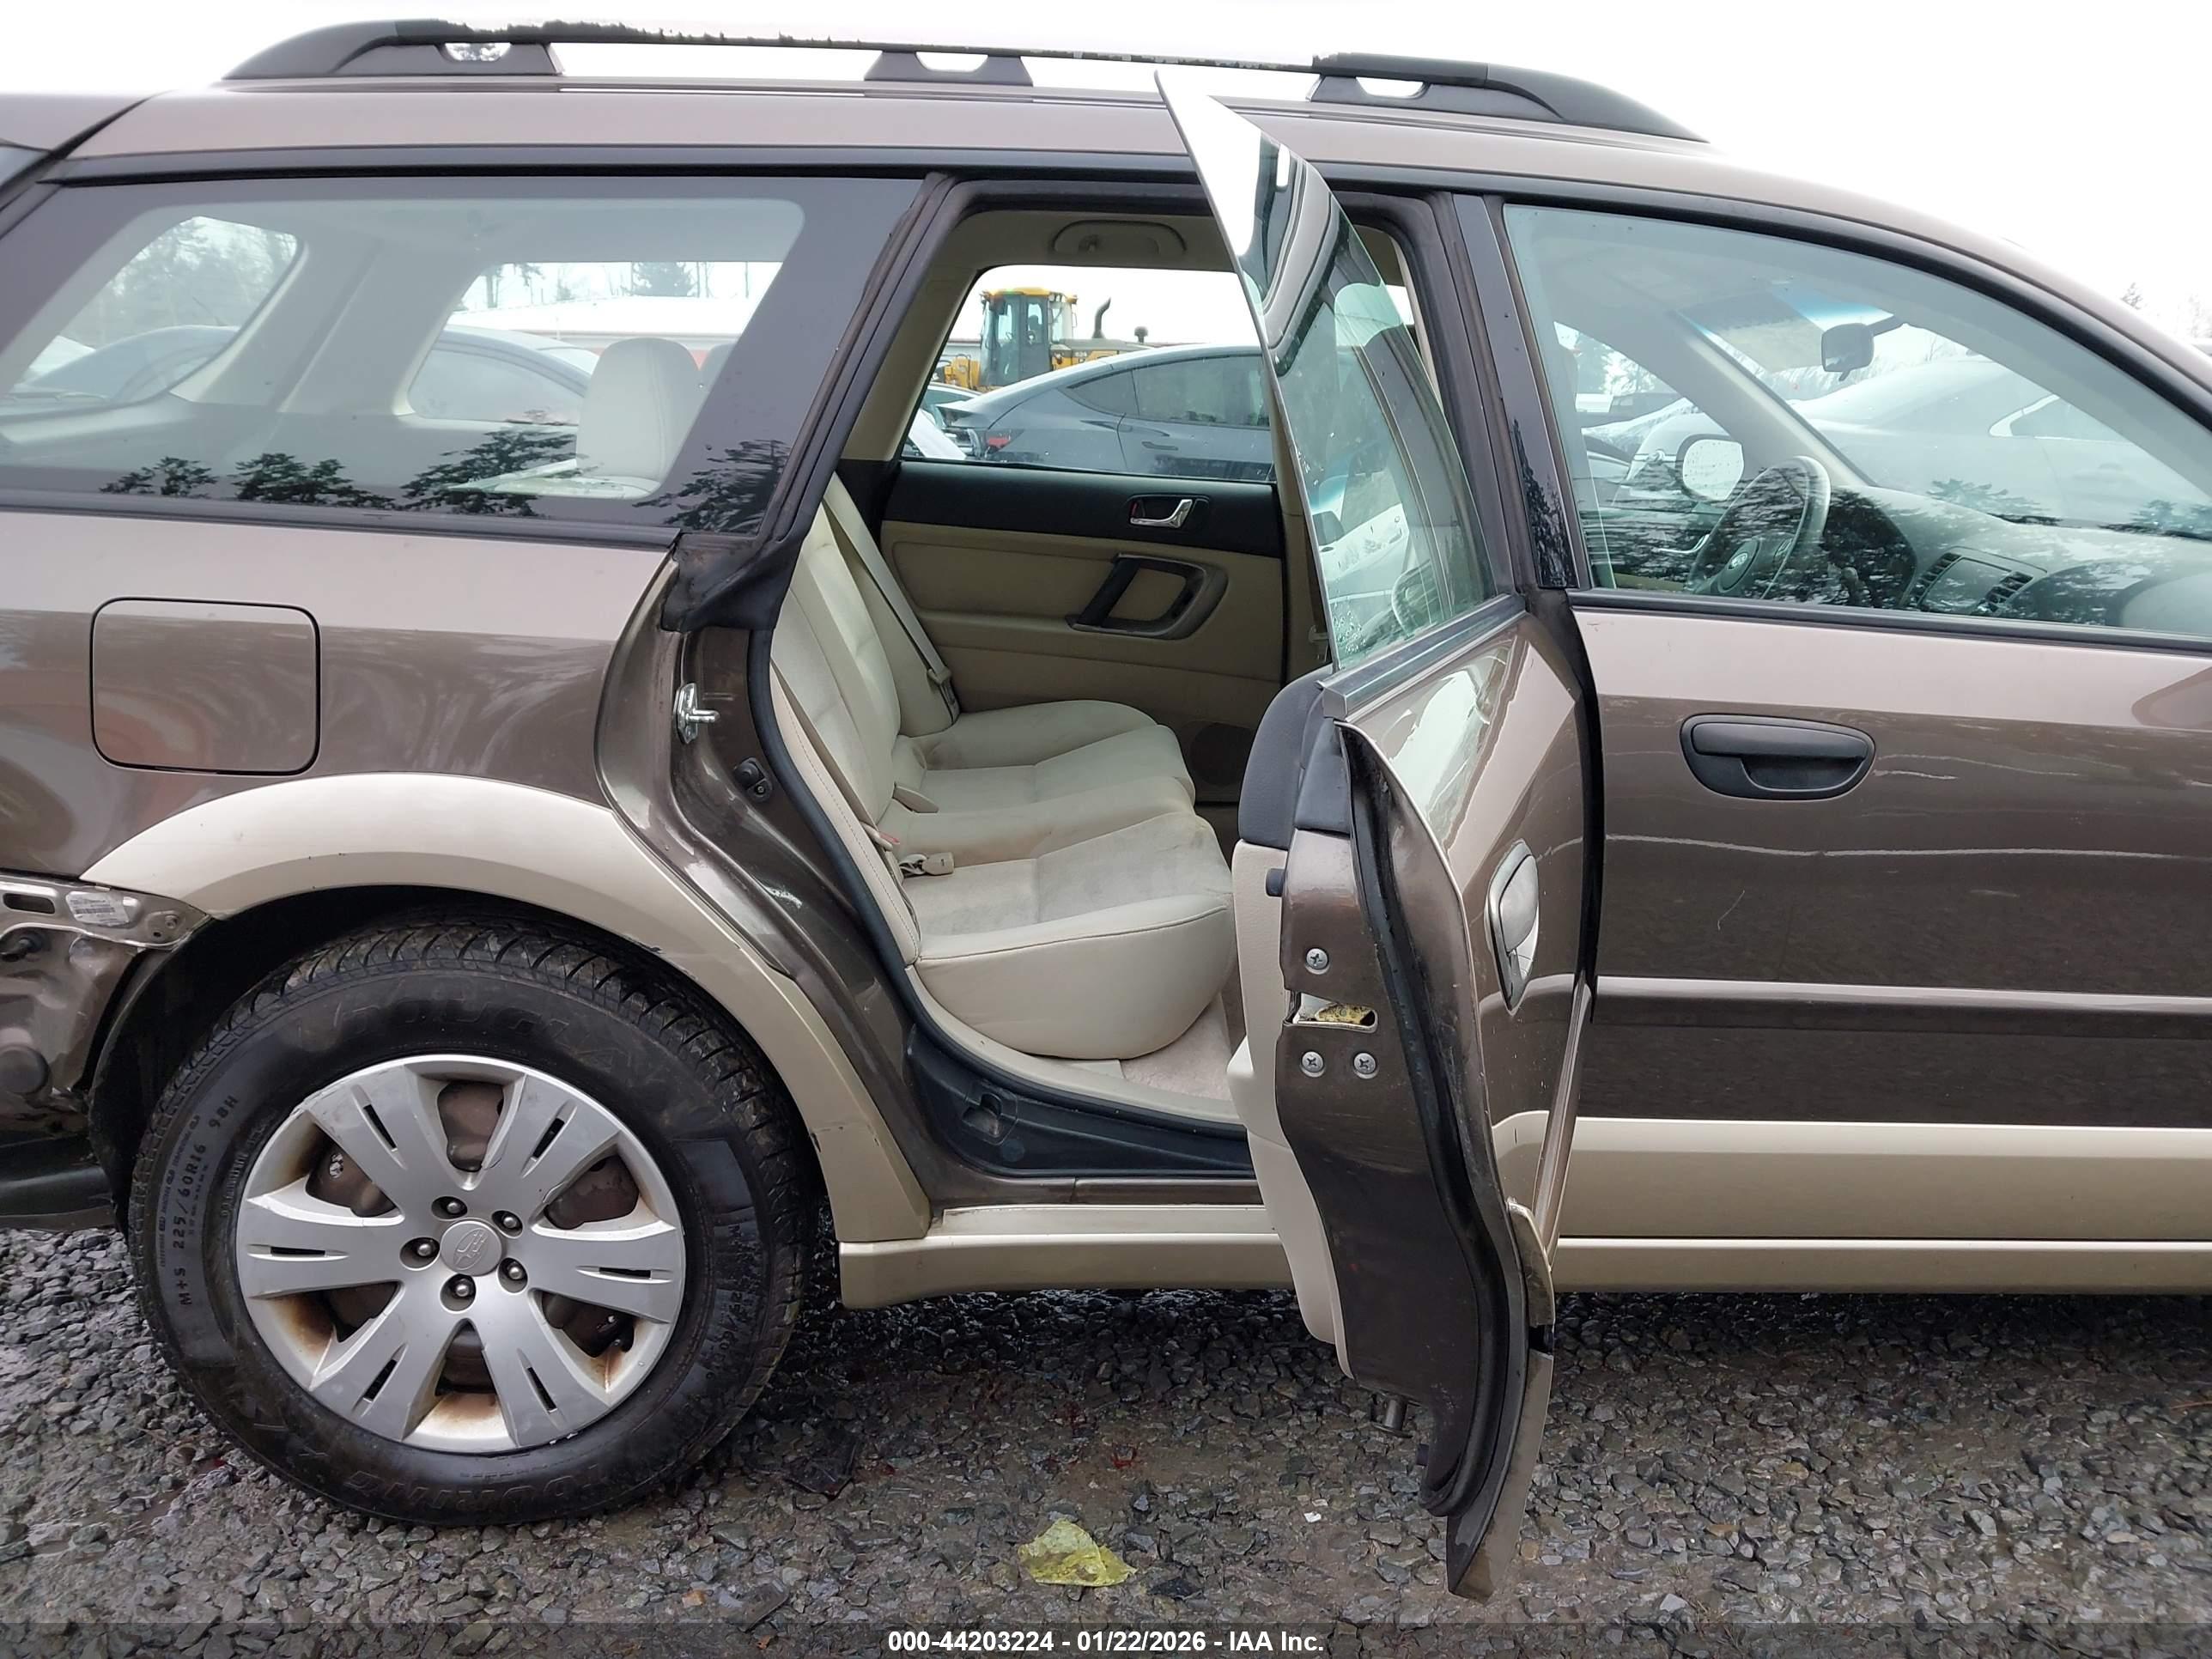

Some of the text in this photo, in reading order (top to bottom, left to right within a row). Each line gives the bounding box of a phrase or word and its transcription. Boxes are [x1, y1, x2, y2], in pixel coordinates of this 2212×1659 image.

[209, 1095, 239, 1127] 98H
[173, 1143, 207, 1249] 225/60R16
[173, 1267, 192, 1305] M+S
